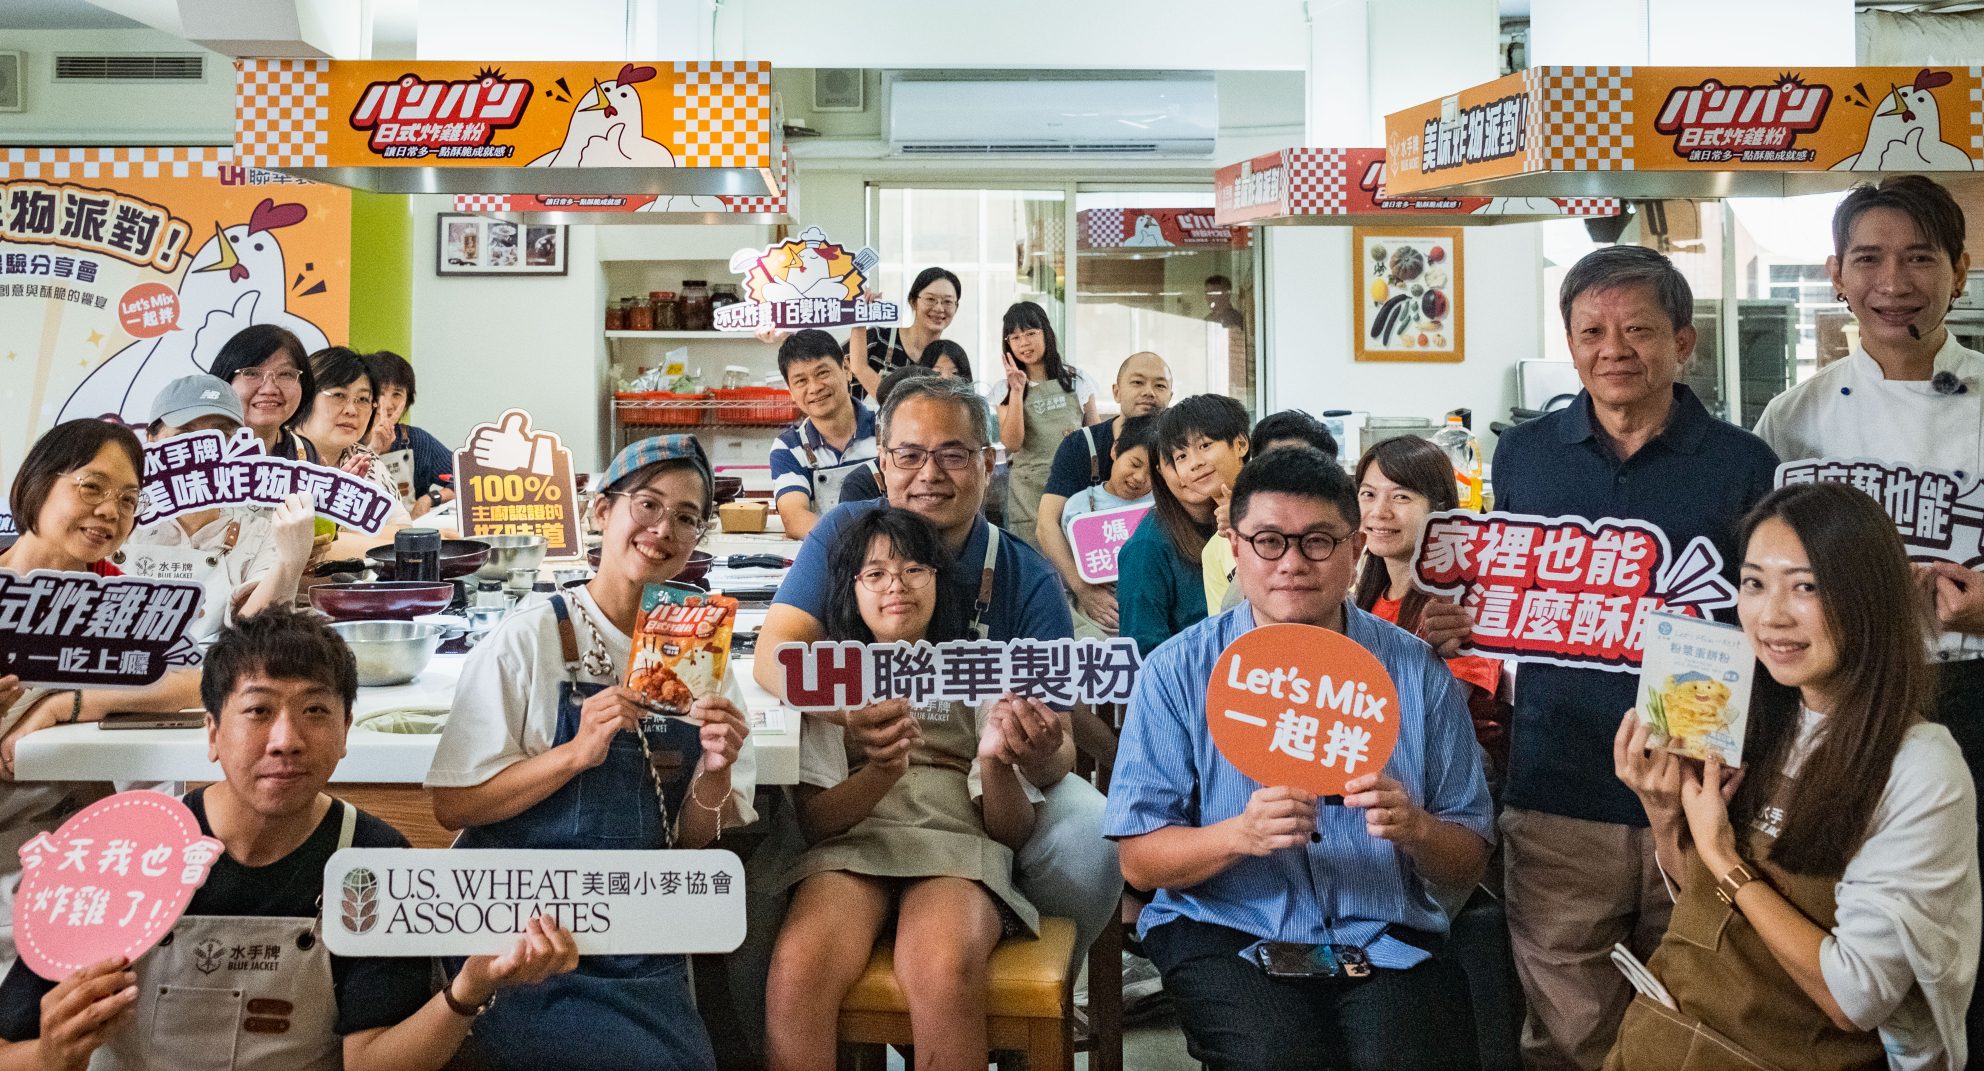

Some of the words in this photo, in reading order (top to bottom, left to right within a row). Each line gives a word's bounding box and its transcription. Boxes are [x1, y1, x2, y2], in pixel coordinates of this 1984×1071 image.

[355, 77, 525, 120] パンパン
[1660, 82, 1828, 124] パンパン
[375, 122, 486, 143] 日式炸雞粉
[1679, 126, 1788, 147] 日式炸雞粉
[384, 146, 515, 158] 讓日常多一點酥脆成就感！
[1689, 150, 1816, 162] 讓日常多一點酥脆成就感！
[0, 190, 181, 263] 物派對！
[0, 253, 99, 283] 驗分享會
[122, 298, 150, 314] Let's
[150, 293, 174, 308] Mix
[127, 307, 174, 328] 一起拌
[716, 299, 896, 327] 不只炸雞！百變炸物一包搞定
[144, 437, 219, 476] 水手牌
[141, 465, 388, 529] 美味炸物派對！
[469, 475, 562, 502] 100%
[472, 504, 564, 522] 主廚認證的
[158, 561, 193, 572] 水手牌
[1423, 521, 1648, 588] 家裡也能
[0, 577, 194, 642] 式炸雞粉
[648, 603, 725, 623] パンパン
[872, 644, 1140, 702] 聯華製粉
[1228, 654, 1311, 704] Let's
[1316, 675, 1387, 723] Mix
[1224, 708, 1372, 774] 一起拌
[22, 836, 219, 884] 今天我也會
[387, 869, 441, 900] U.S.
[452, 869, 577, 900] WHEAT
[582, 870, 733, 896] 美國小麥協會
[33, 884, 163, 932] 炸雞了！
[385, 902, 611, 934] ASSOCIATES
[227, 961, 249, 971] BLUE
[250, 961, 279, 971] JACKET
[229, 944, 281, 961] 水手牌
